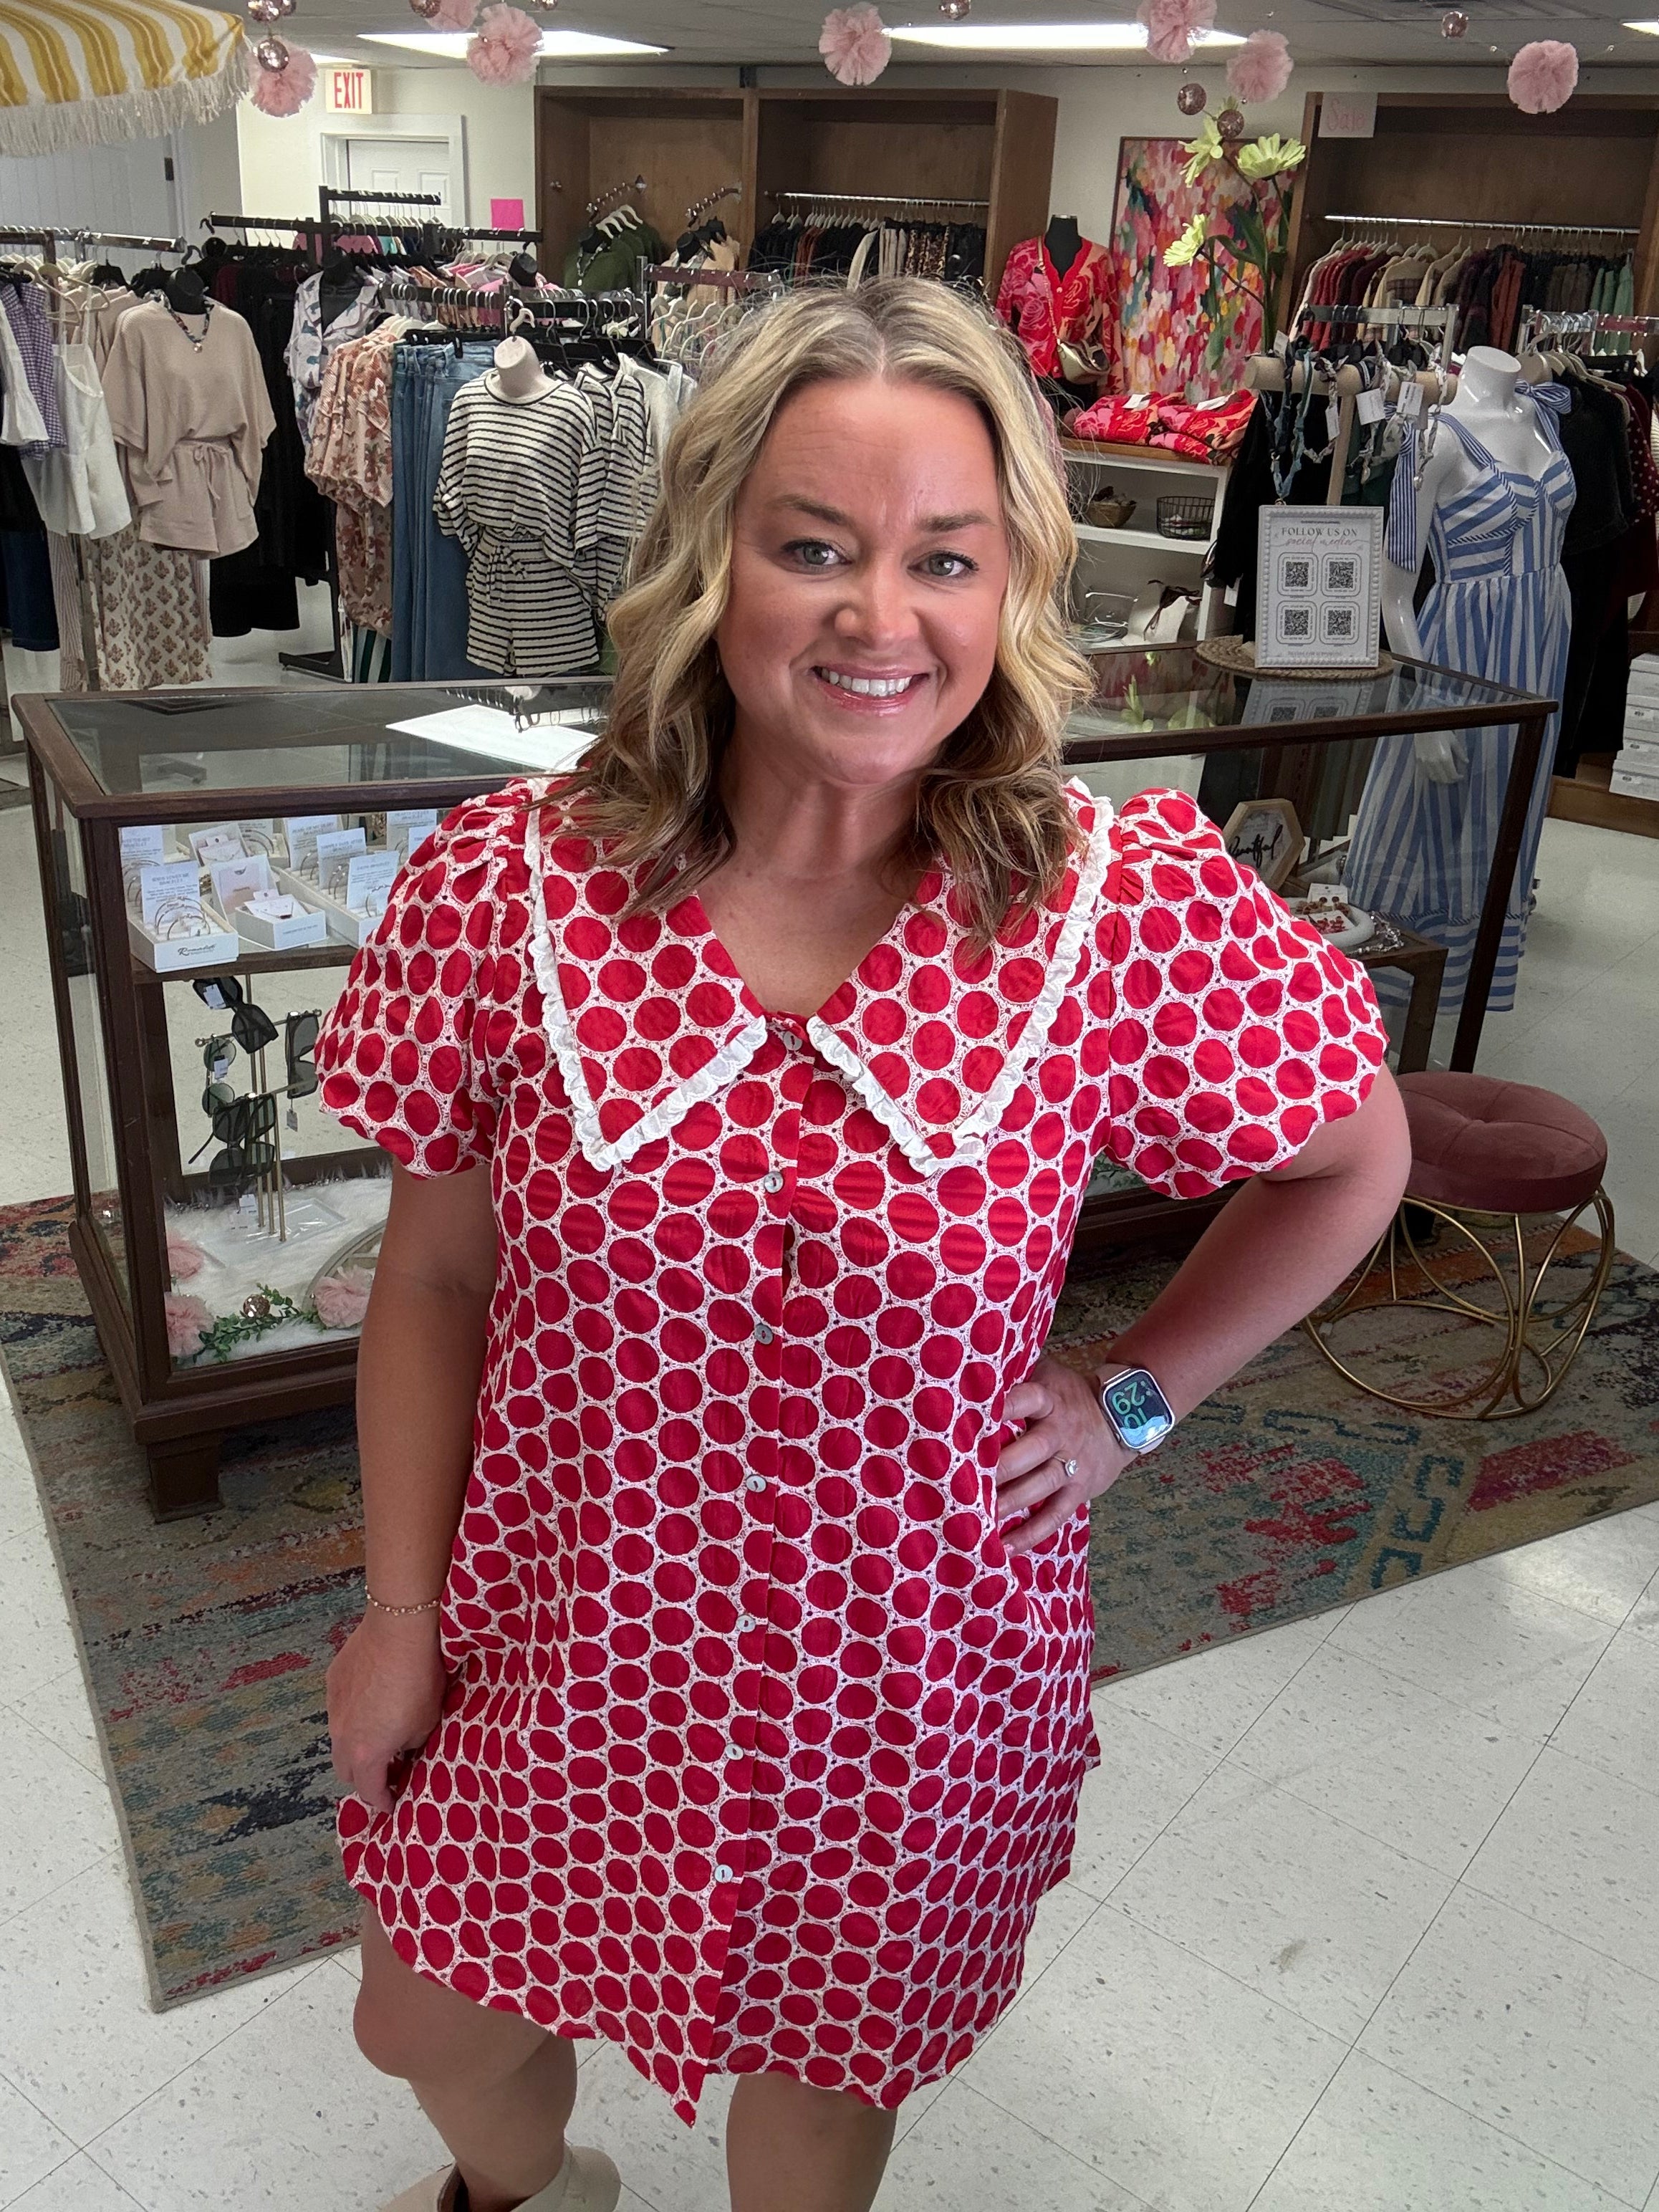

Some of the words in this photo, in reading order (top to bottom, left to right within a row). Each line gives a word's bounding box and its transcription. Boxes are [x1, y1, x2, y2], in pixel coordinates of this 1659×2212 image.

[334, 72, 364, 109] EXIT
[1281, 527, 1323, 536] FOLLOW
[1327, 528, 1340, 537] US
[1343, 528, 1359, 537] ON
